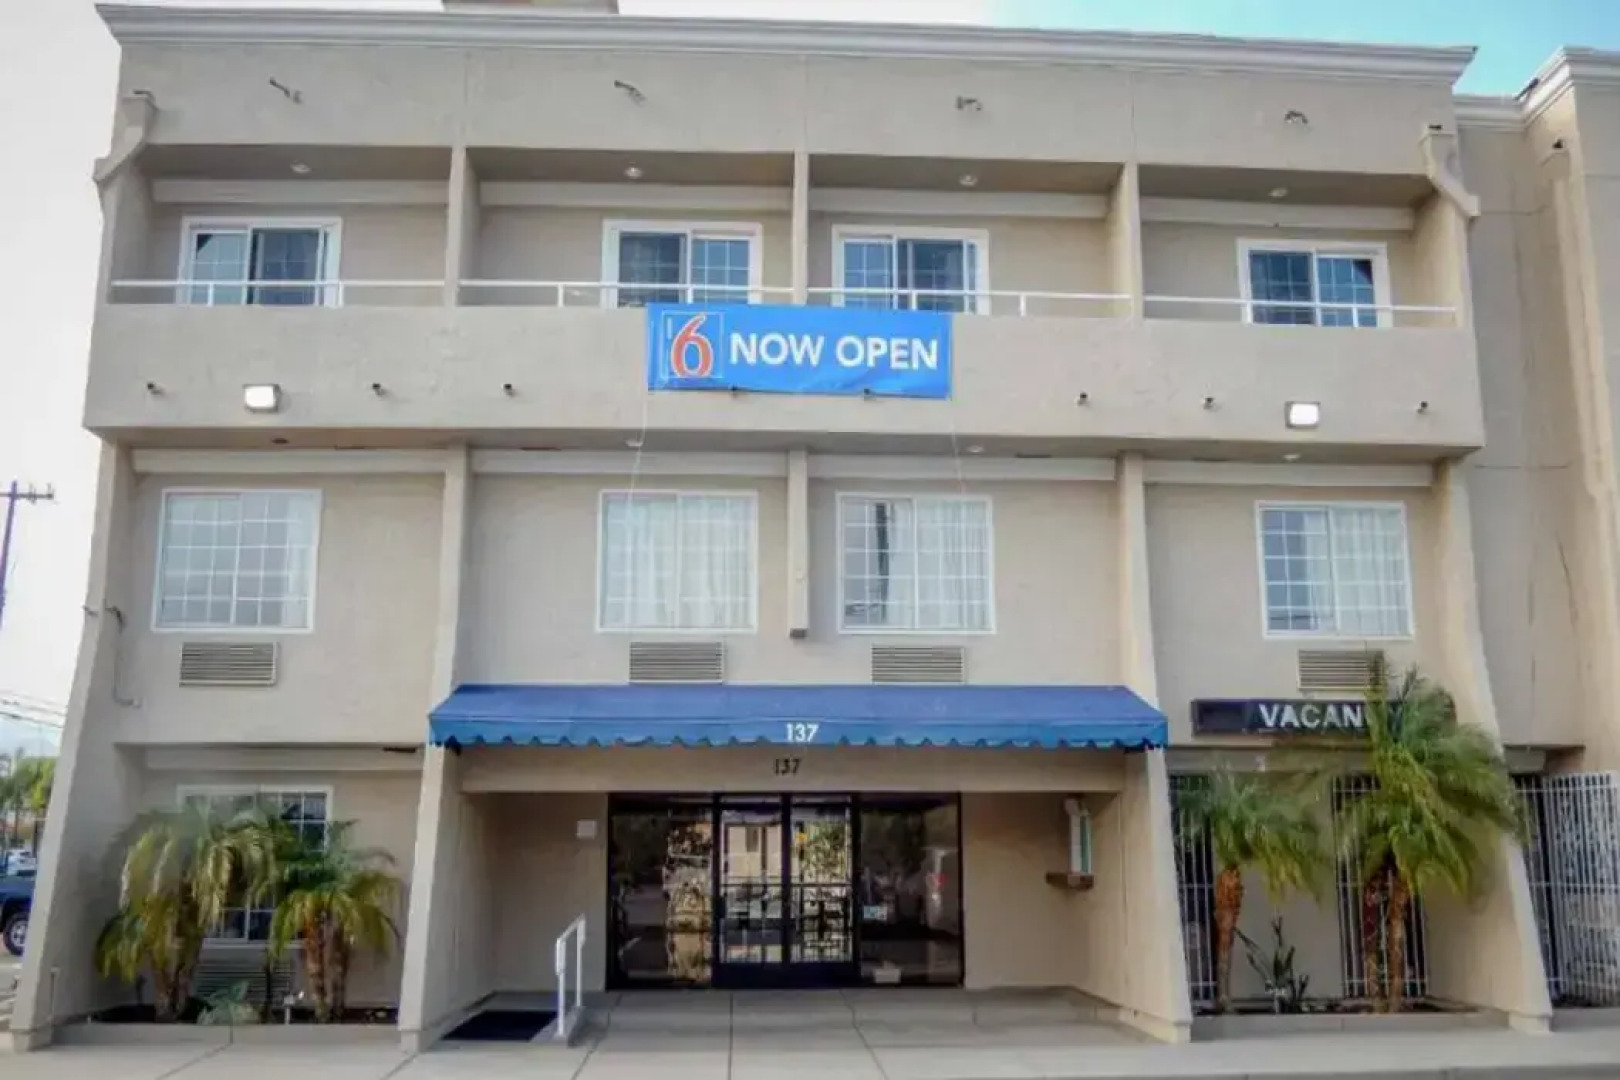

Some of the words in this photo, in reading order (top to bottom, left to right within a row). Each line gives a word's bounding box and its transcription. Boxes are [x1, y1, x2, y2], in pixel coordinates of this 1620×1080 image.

[671, 313, 714, 377] 6
[730, 333, 824, 366] NOW
[836, 337, 938, 370] OPEN
[786, 722, 819, 742] 137
[774, 758, 801, 776] 137
